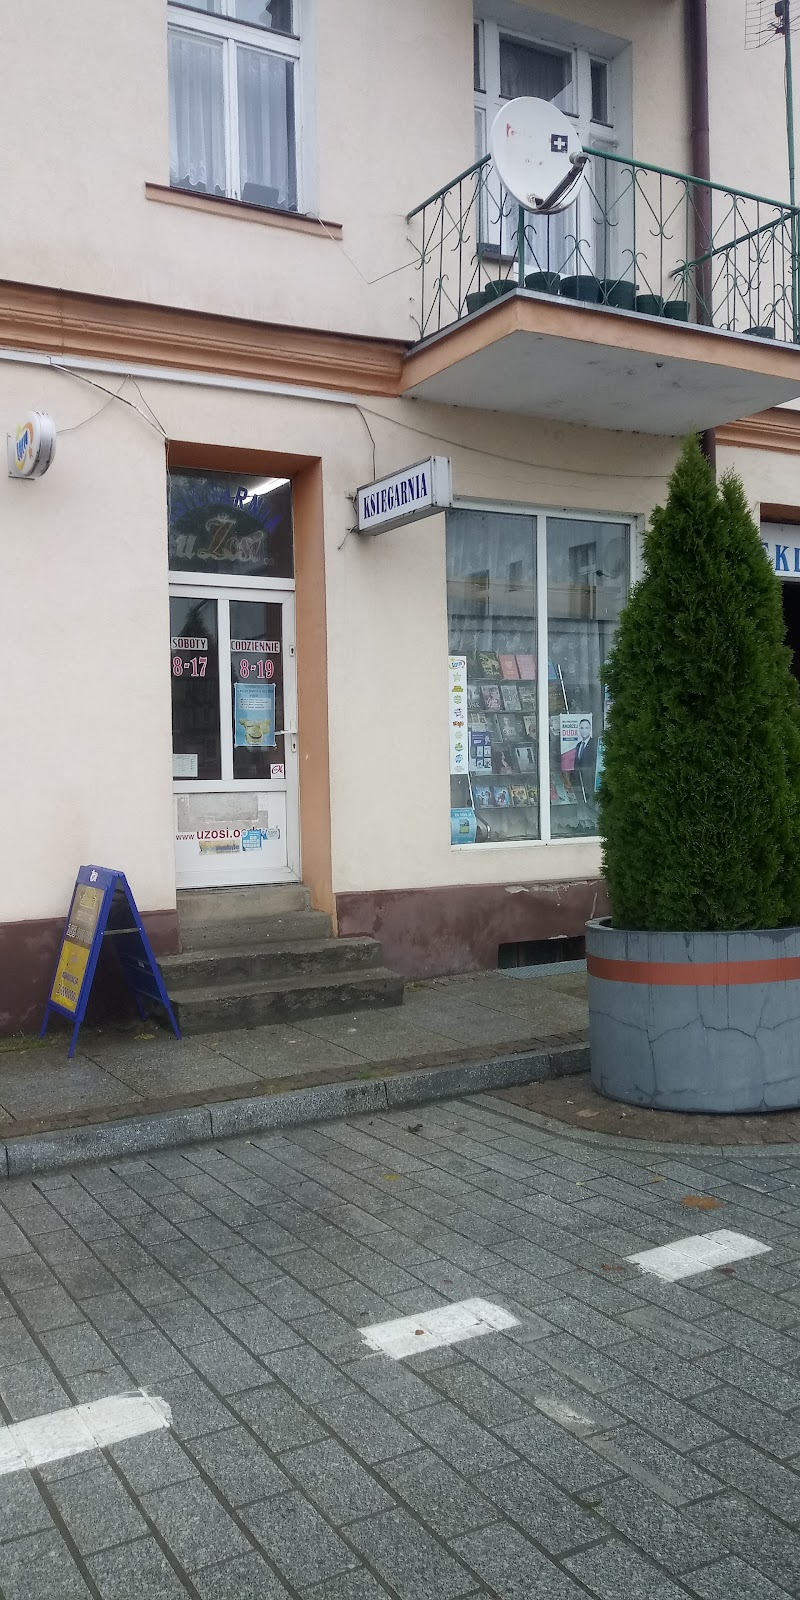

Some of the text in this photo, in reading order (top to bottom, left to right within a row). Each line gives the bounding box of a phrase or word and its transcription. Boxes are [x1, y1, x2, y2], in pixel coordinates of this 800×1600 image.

[172, 638, 206, 649] SOBOTY
[231, 640, 279, 653] CODZIENNIE
[172, 656, 208, 677] 8-17
[240, 658, 275, 679] 8-19
